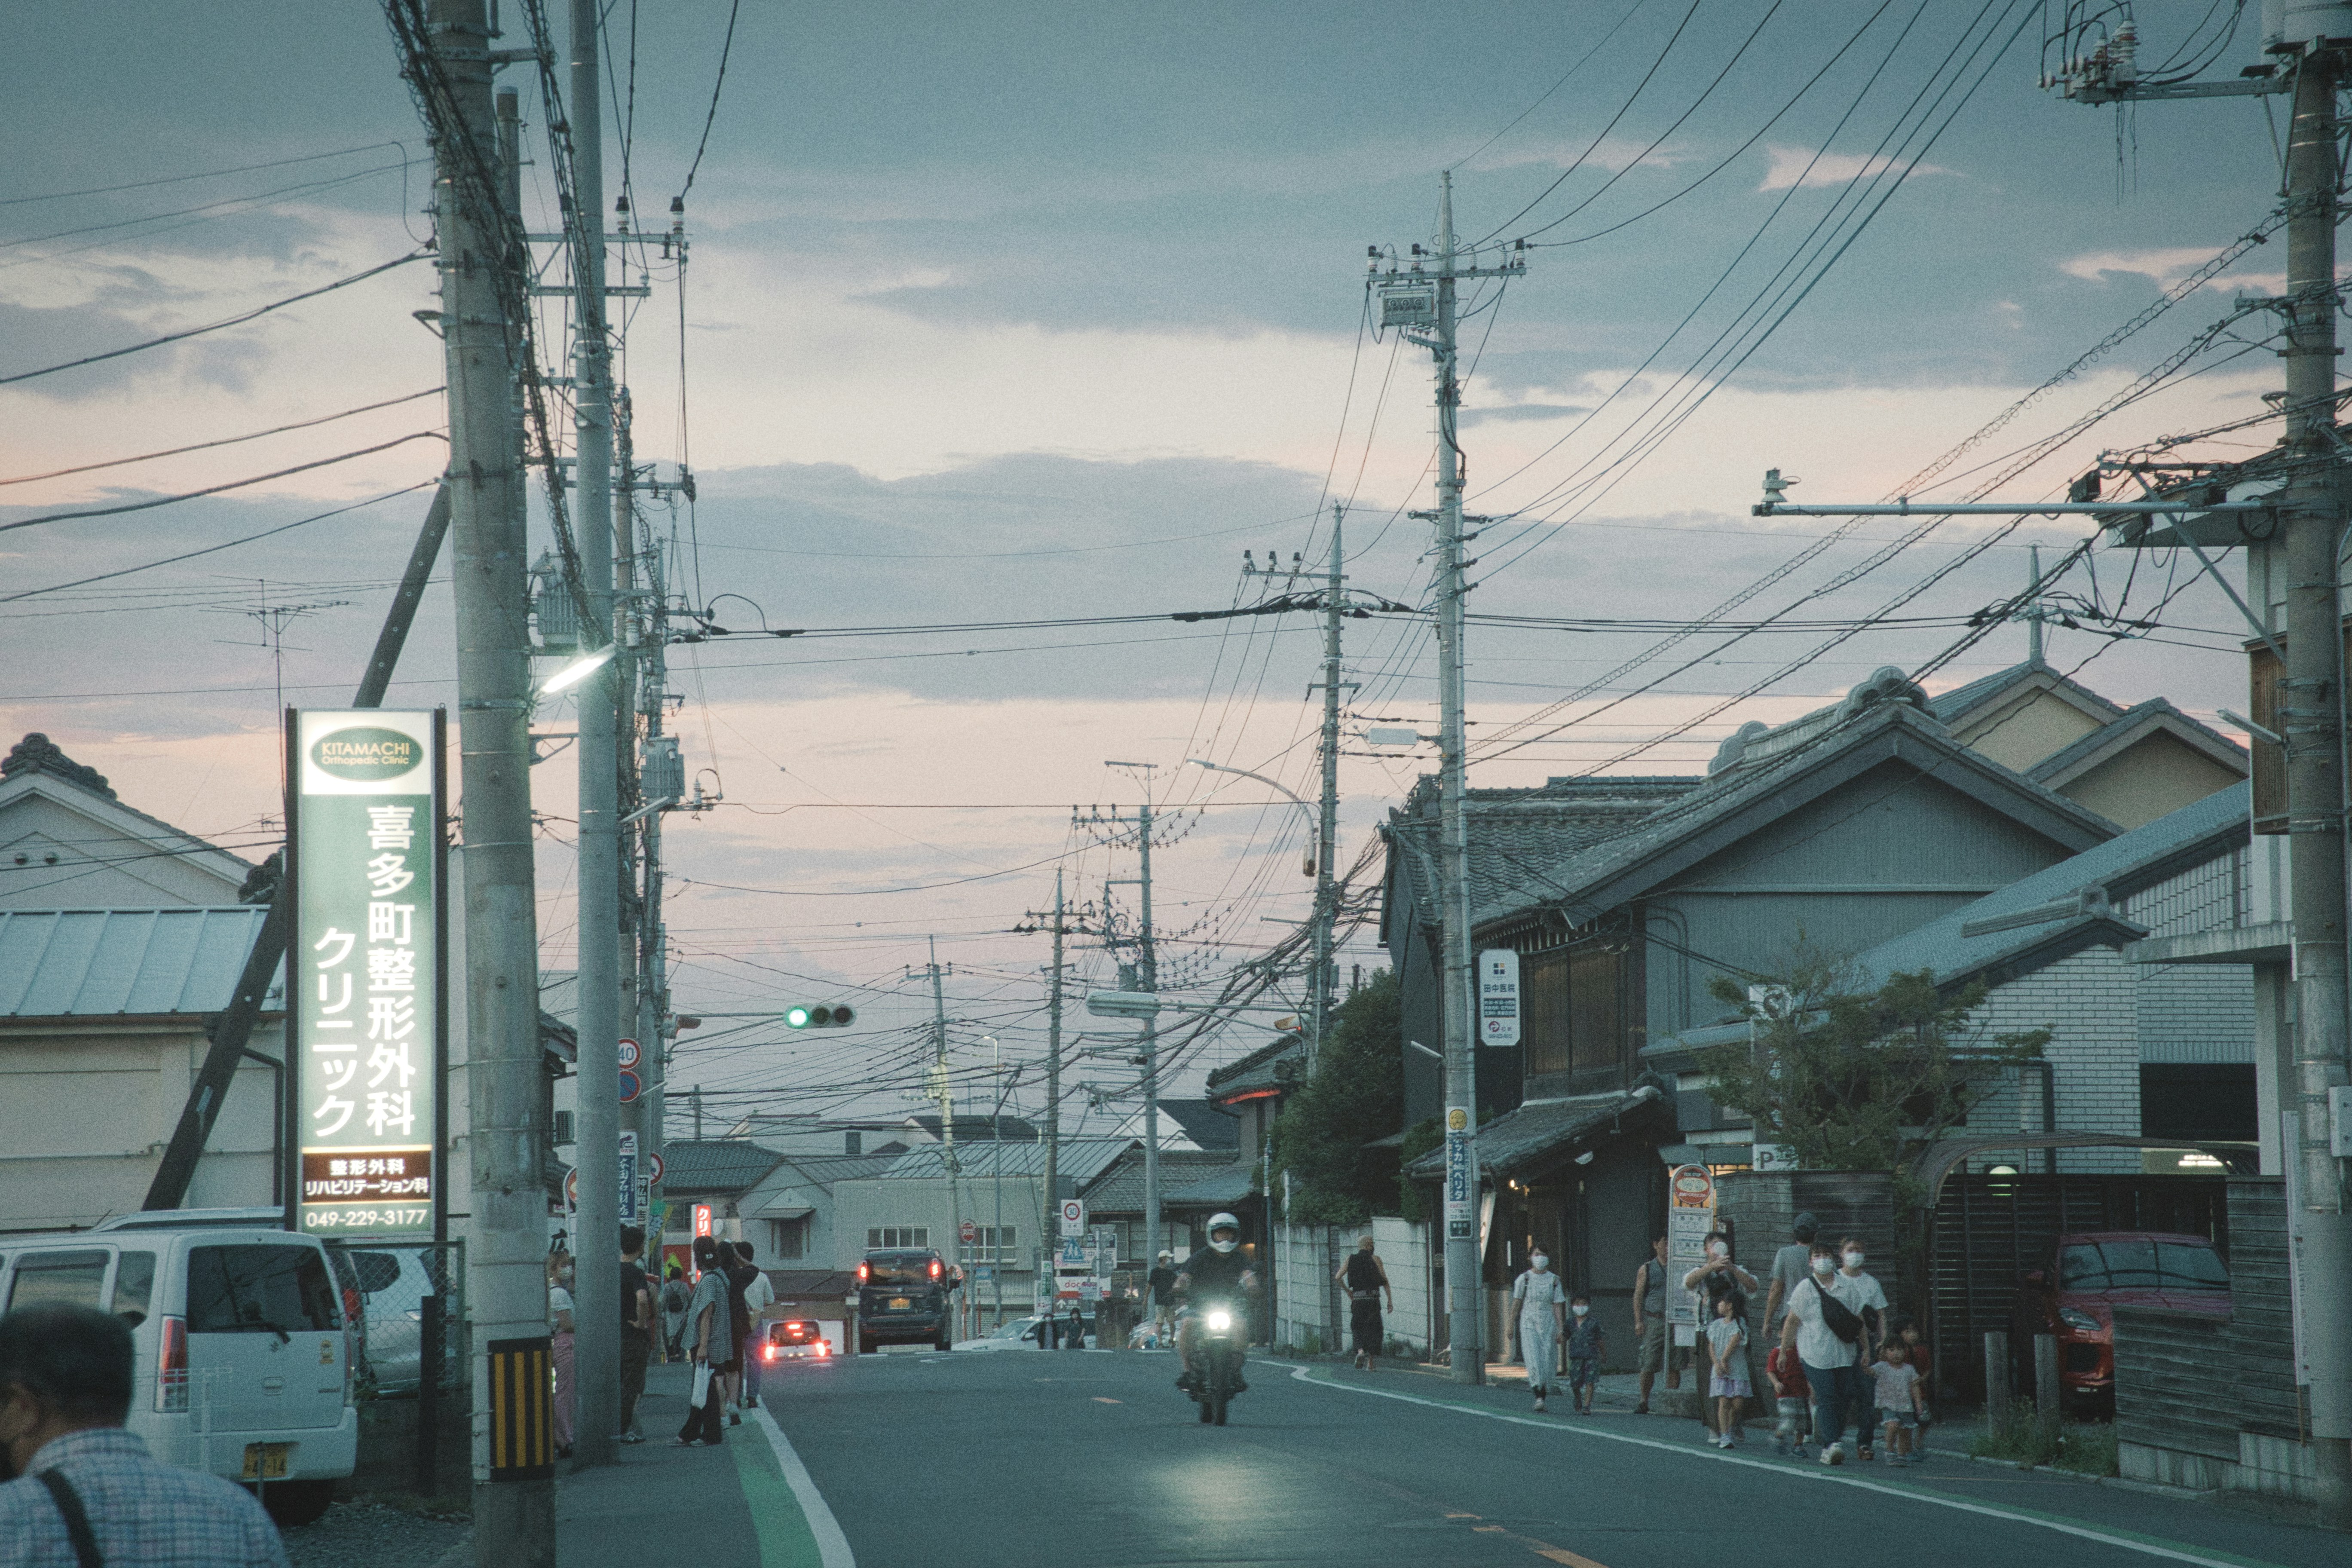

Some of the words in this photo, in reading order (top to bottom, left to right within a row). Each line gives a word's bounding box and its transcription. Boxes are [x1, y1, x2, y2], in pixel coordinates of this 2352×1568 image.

[322, 742, 410, 755] KITAMACHI
[322, 756, 379, 765] Orthopedic
[381, 756, 409, 764] Clinic
[367, 805, 415, 1136] 喜多町整形外科
[313, 927, 357, 1136] クリニック
[619, 1047, 634, 1060] 40
[331, 1158, 405, 1176] 整形外科
[1760, 1152, 1774, 1169] P
[306, 1177, 429, 1195] リハビリテーション科
[306, 1209, 428, 1227] 049-229-3177
[698, 1207, 708, 1236] クリ
